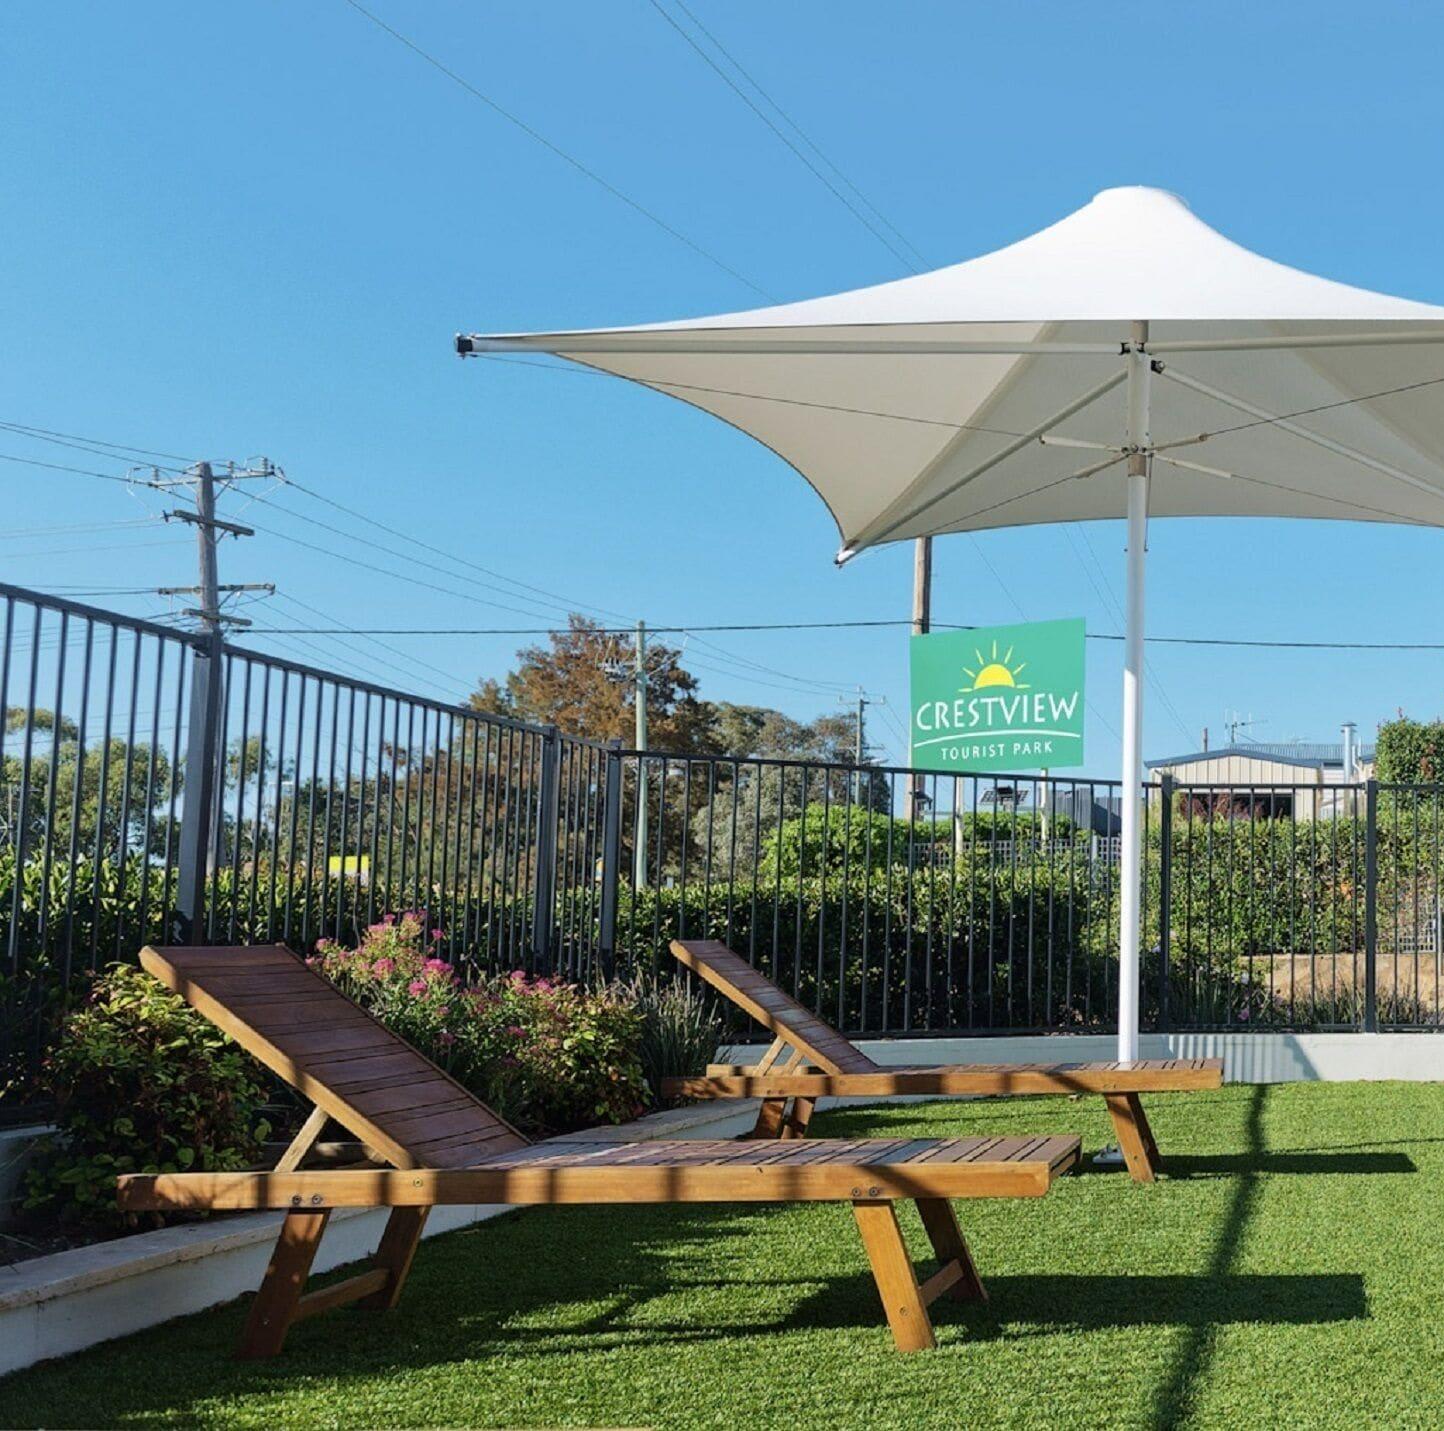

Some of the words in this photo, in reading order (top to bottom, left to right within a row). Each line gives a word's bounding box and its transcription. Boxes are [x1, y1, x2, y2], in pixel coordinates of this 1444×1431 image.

[916, 691, 1079, 731] CRESTVIEW
[941, 744, 1004, 760] TOURIST
[1013, 741, 1053, 755] PARK
